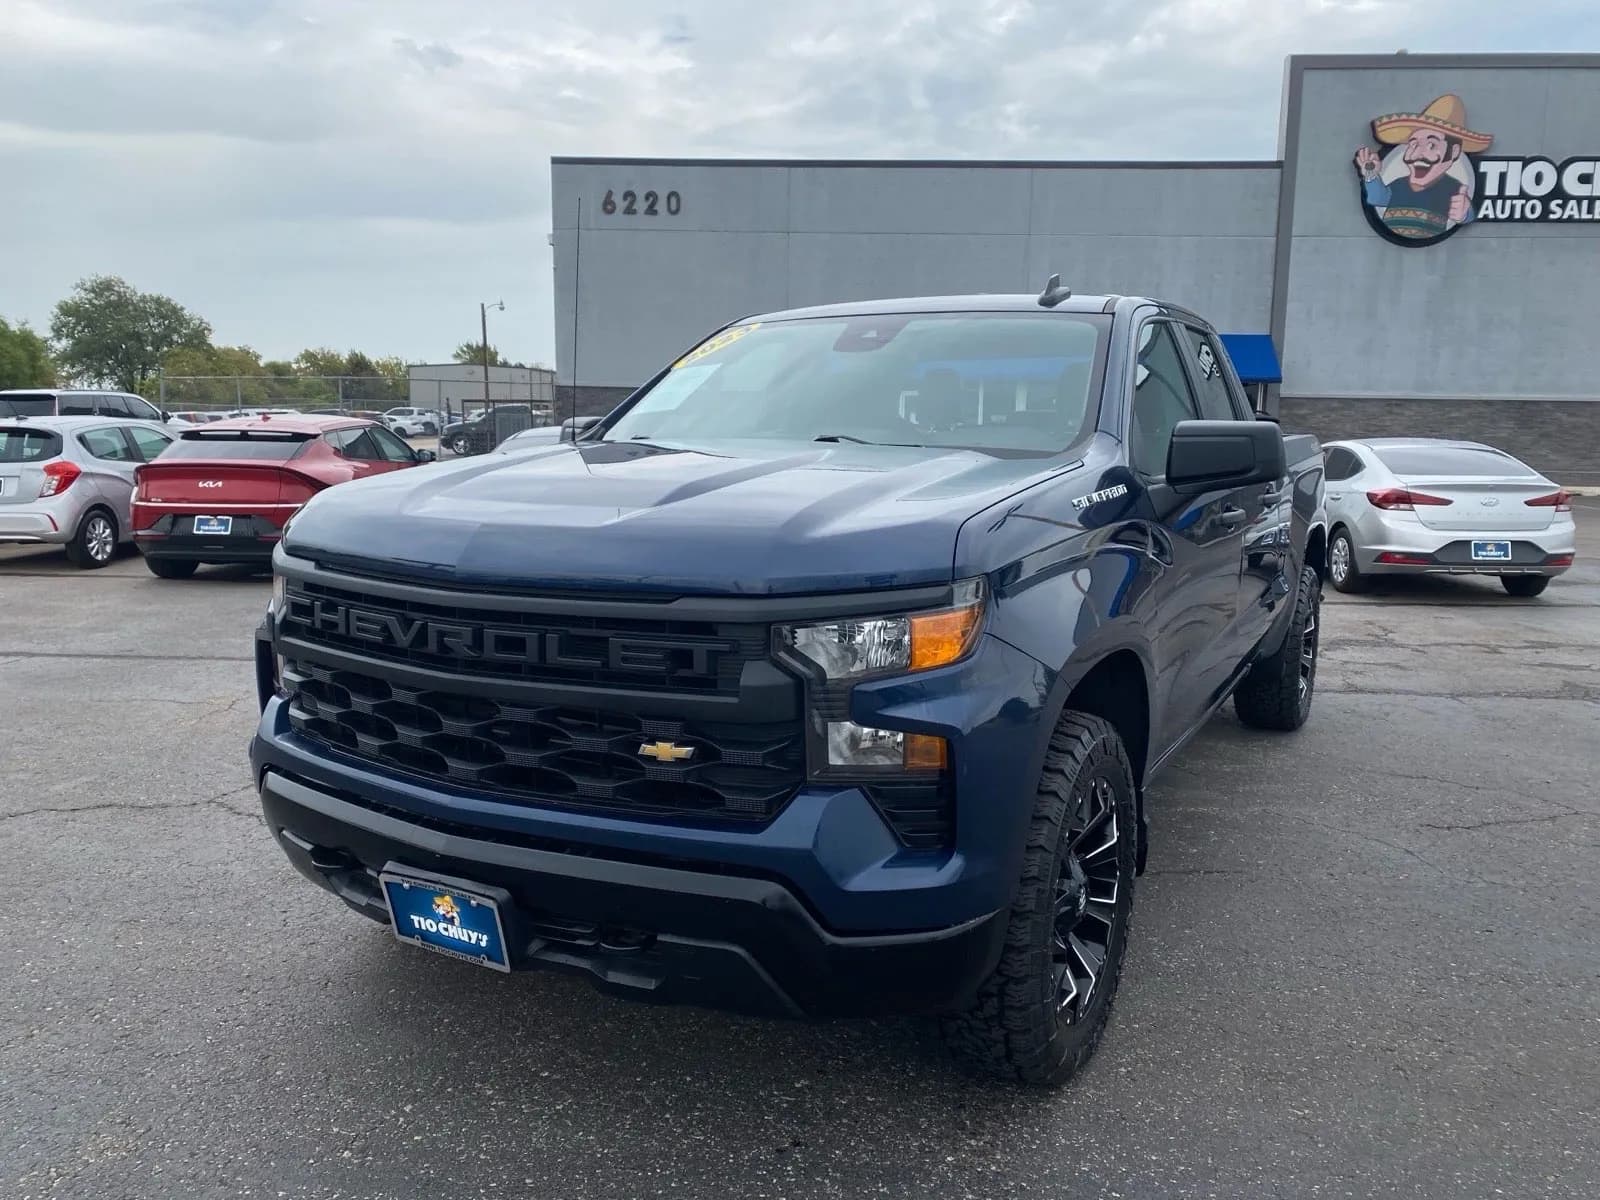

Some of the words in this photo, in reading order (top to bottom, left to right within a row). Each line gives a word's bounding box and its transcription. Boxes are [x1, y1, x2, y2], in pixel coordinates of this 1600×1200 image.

[1479, 160, 1558, 196] TIO
[601, 189, 681, 216] 6220
[1477, 199, 1542, 219] AUTO
[198, 480, 223, 488] KIA
[286, 594, 730, 676] CHEVROLET
[410, 914, 438, 933] TIO
[438, 922, 488, 947] CHUY'S
